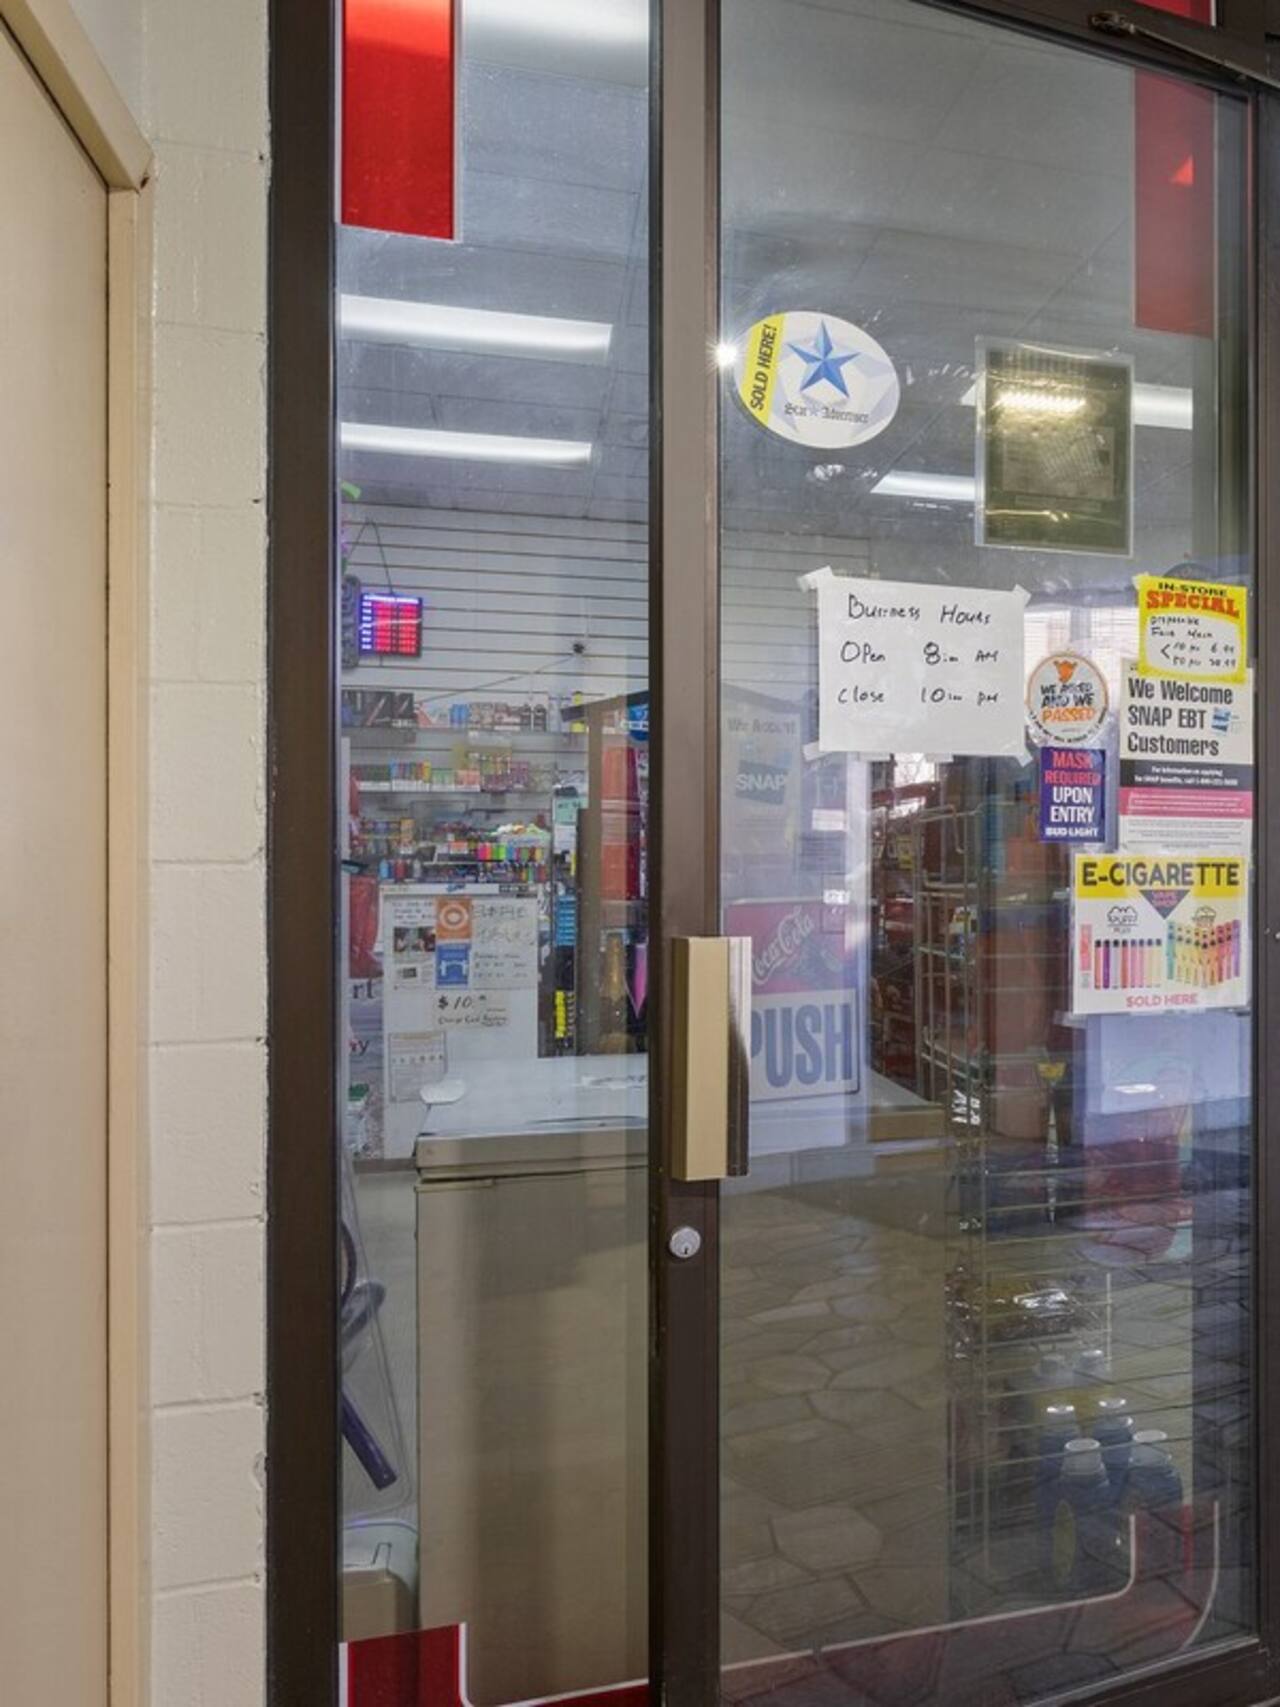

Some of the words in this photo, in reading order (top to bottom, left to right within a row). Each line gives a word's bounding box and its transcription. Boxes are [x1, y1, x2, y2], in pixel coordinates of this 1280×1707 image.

[757, 324, 777, 369] HERE!
[750, 371, 768, 411] SOLD
[1158, 582, 1228, 597] IN-STORE
[940, 604, 991, 625] Hours
[1146, 590, 1240, 619] SPECIAL
[1128, 677, 1154, 699] We
[1160, 680, 1233, 704] Welcome
[1128, 704, 1172, 727] SNAP
[1178, 708, 1207, 729] EBT
[1127, 731, 1219, 756] Customers
[1052, 751, 1093, 769] MASK
[736, 773, 785, 792] SNAP
[1044, 769, 1101, 786] REQUIRED
[1053, 786, 1093, 803] UPON
[1051, 805, 1095, 823] ENTRY
[1045, 827, 1067, 837] BUD
[1068, 827, 1099, 838] LIGHT
[1082, 861, 1239, 887] E-CIGARETTE
[1126, 994, 1160, 1008] SOLD
[1164, 993, 1198, 1006] HERE
